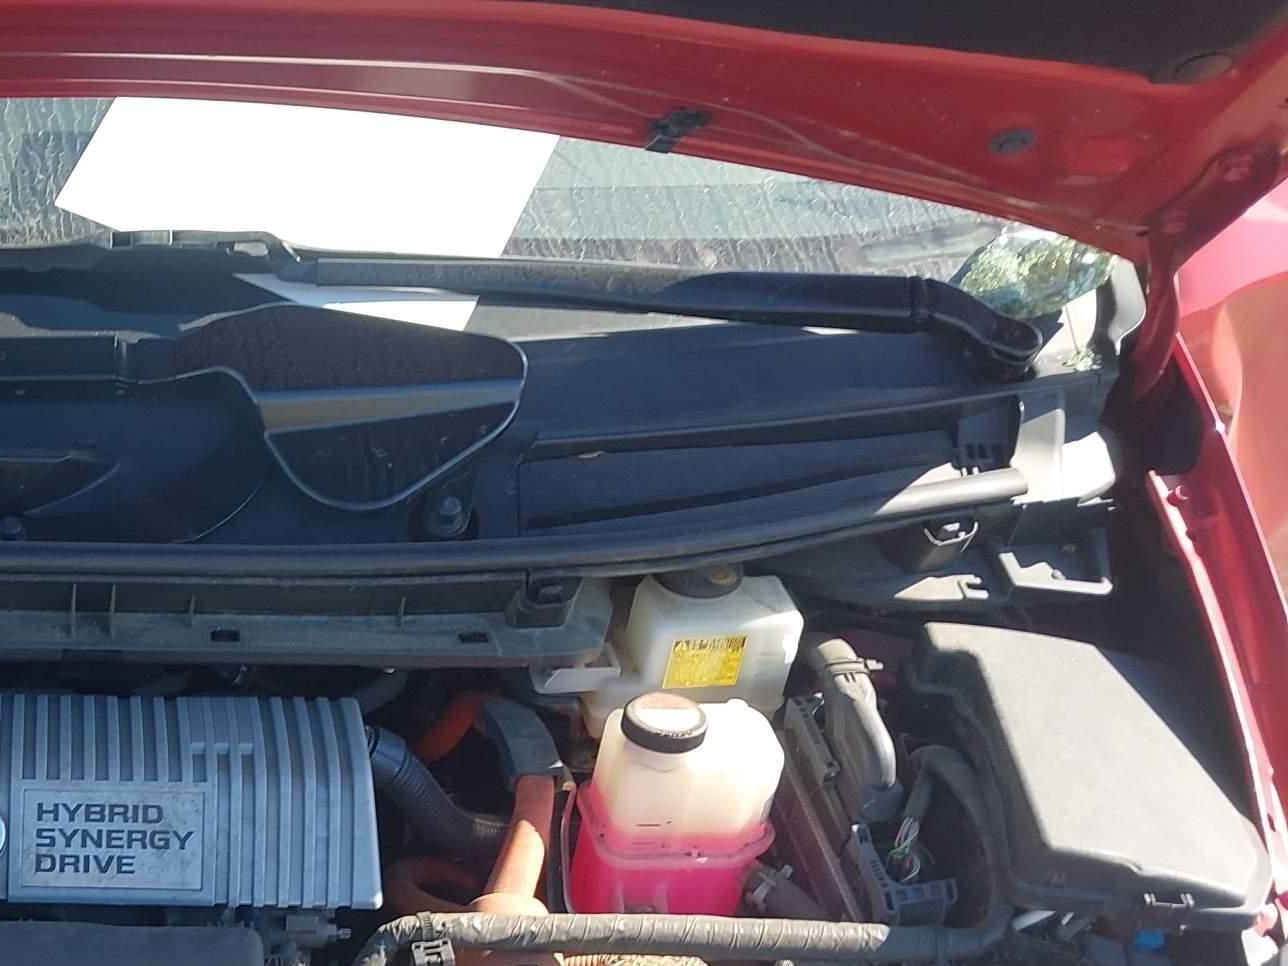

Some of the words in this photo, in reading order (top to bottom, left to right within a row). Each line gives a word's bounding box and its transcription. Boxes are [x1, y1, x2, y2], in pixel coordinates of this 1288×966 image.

[37, 802, 164, 824] HYBRID
[35, 828, 194, 850] SYNERGY
[35, 854, 136, 875] DRIVE
